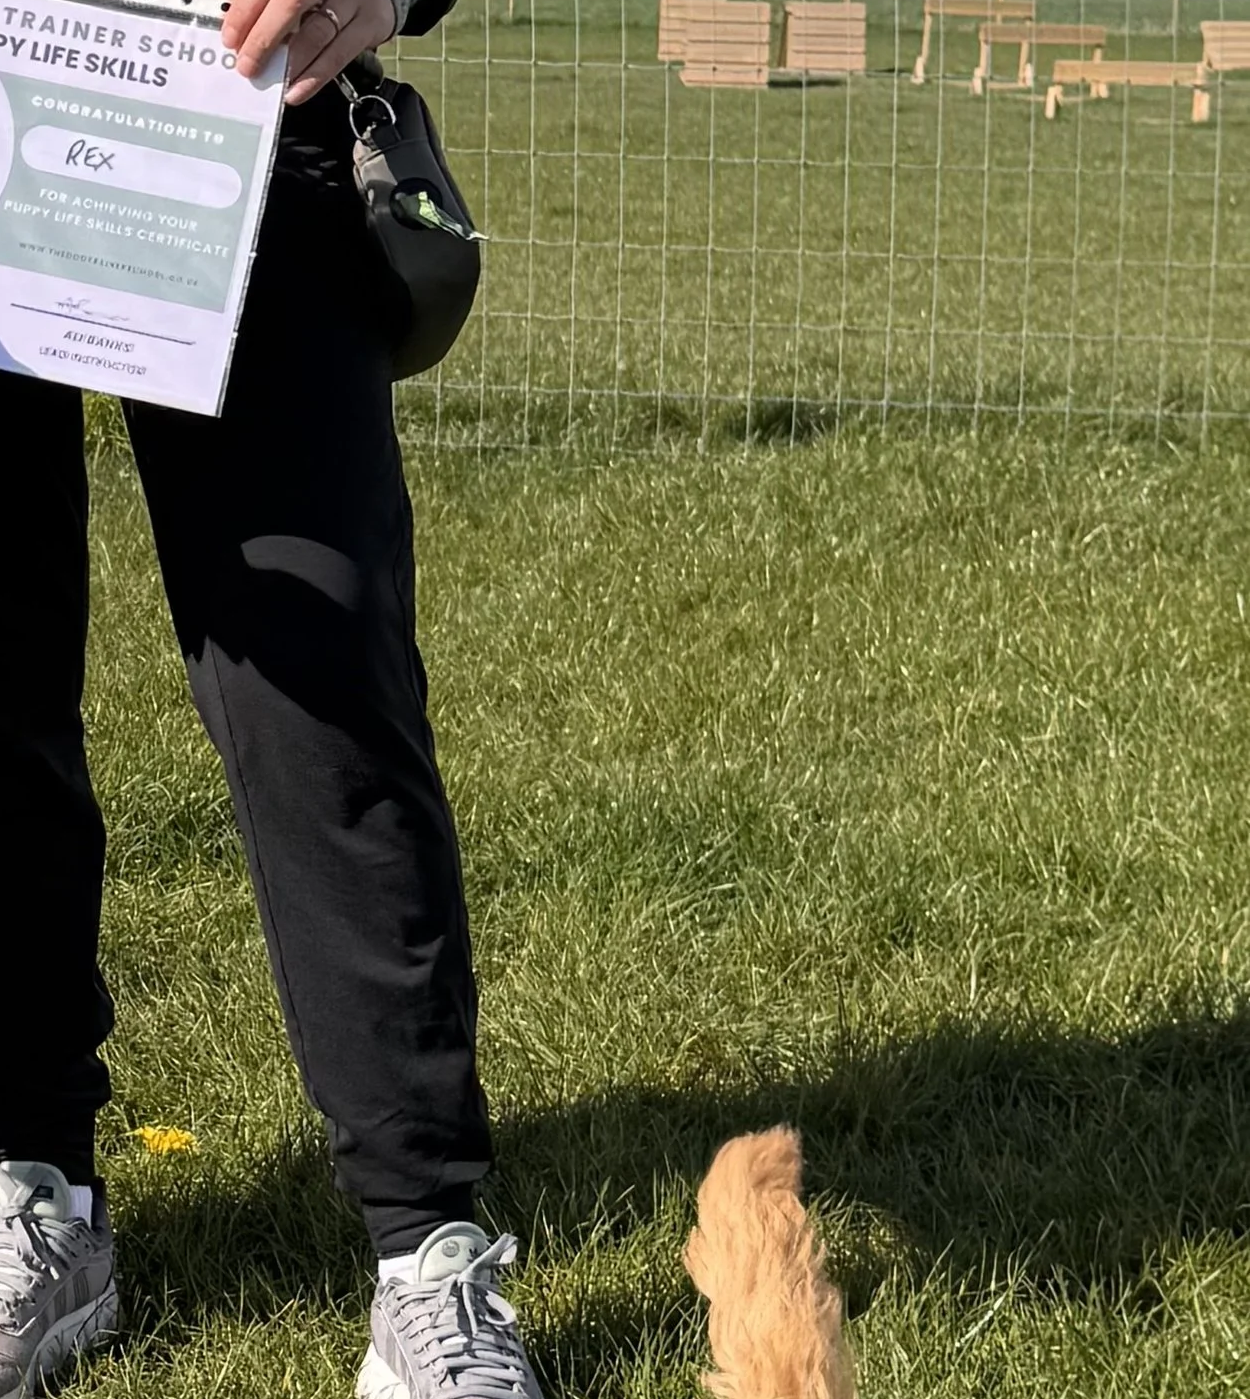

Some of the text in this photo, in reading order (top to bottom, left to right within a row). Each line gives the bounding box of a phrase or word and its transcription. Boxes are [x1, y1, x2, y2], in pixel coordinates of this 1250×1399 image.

[3, 5, 127, 49] TRAINER
[137, 34, 239, 71] SCHOO
[29, 41, 82, 70] LIFE
[83, 52, 169, 88] SKILLS
[31, 94, 225, 146] CONGRATULATIONS TO
[65, 138, 116, 172] REX
[3, 199, 231, 259] PUPPY LIFE SKILLS CERTIFICATE
[38, 187, 199, 233] FOR ACHIEVING YOUR
